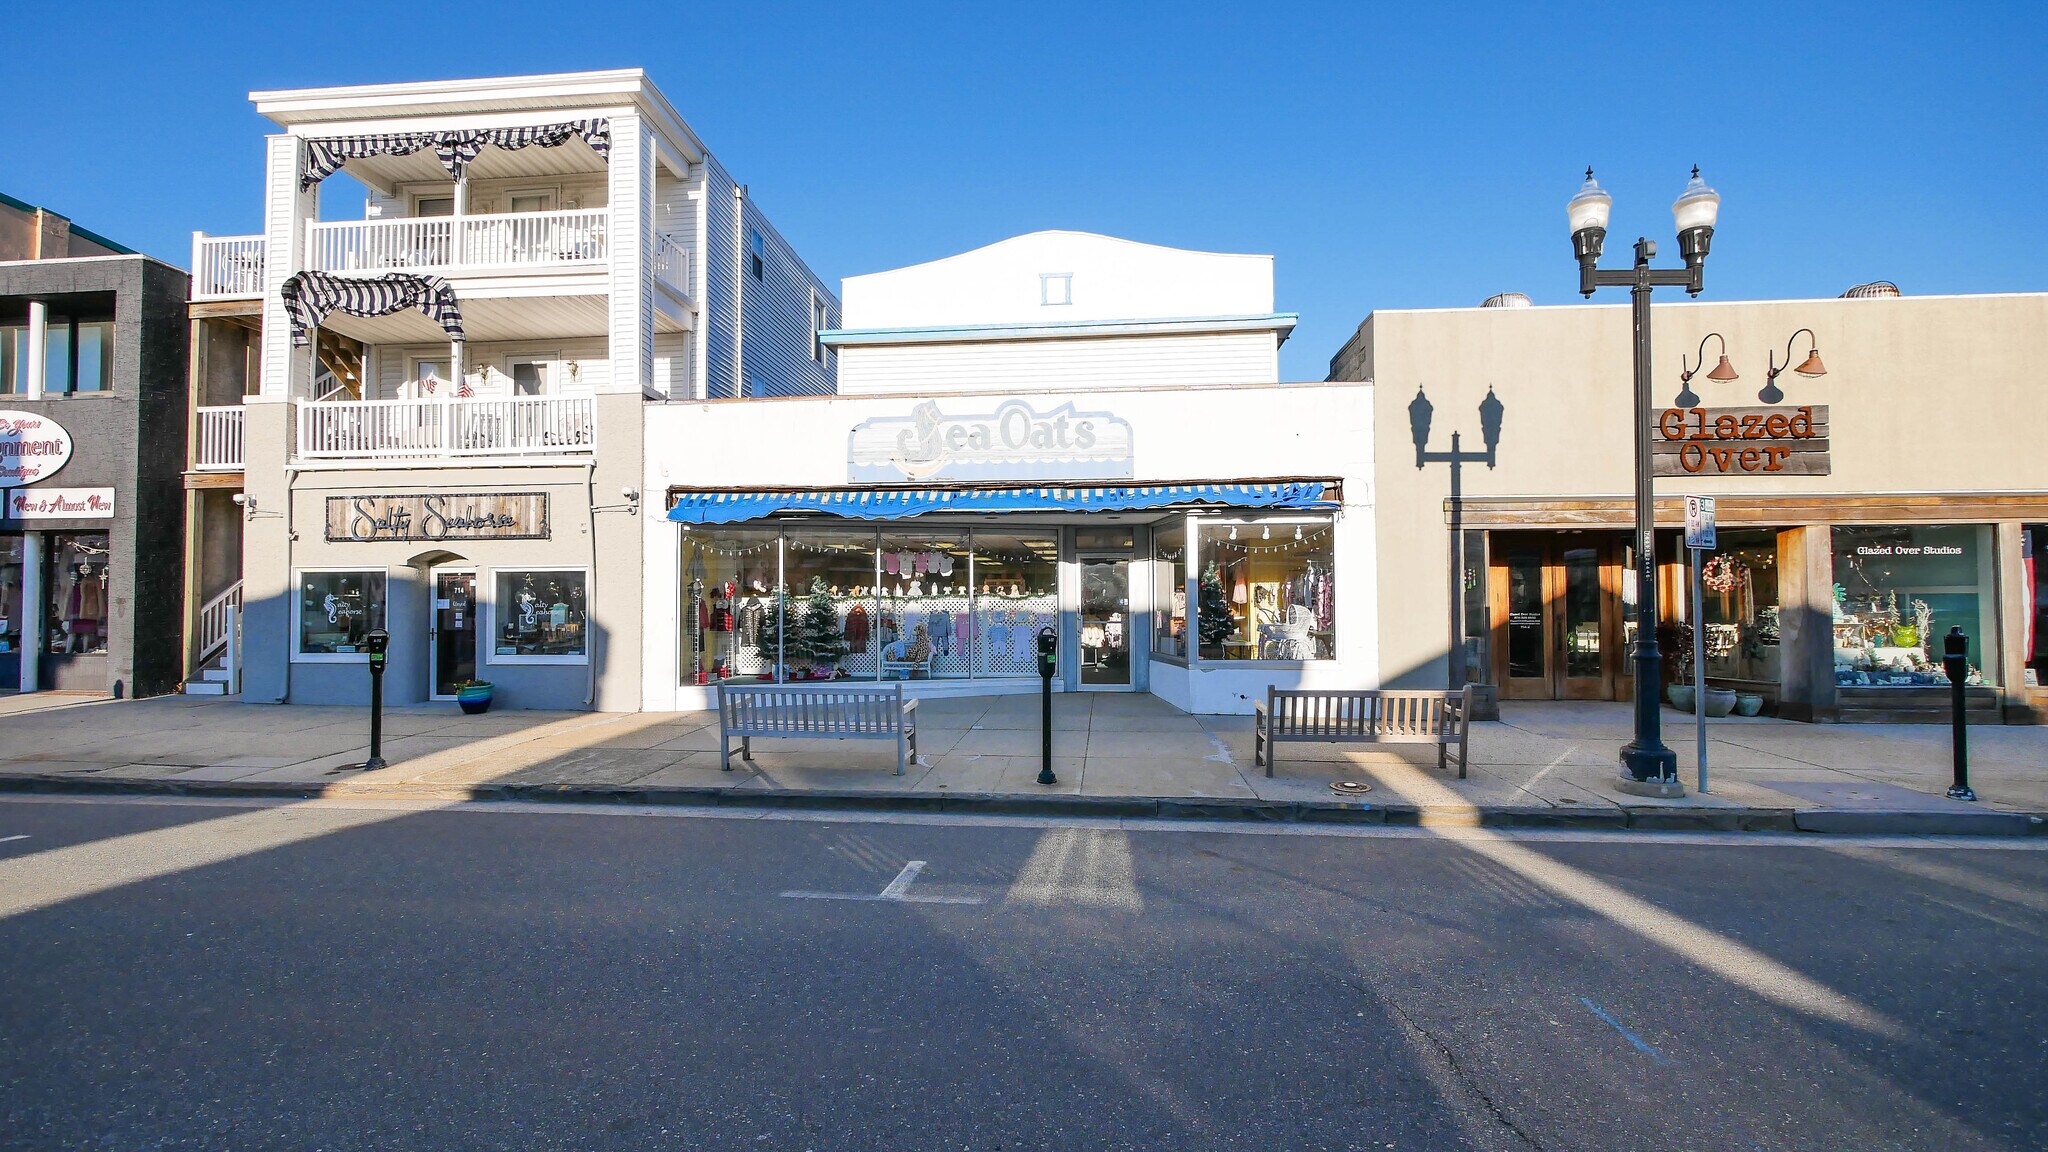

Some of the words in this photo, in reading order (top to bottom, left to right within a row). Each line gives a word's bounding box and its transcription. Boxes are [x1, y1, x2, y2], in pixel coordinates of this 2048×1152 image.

[896, 400, 991, 463] Sea
[1000, 408, 1096, 450] Oats
[1660, 406, 1816, 440] Glazed
[1680, 441, 1791, 473] Over
[13, 495, 38, 512] New
[48, 494, 86, 514] Almost
[87, 494, 112, 511] New
[351, 495, 411, 542] Salty
[422, 494, 516, 540] Seahorse
[1857, 546, 1892, 555] Glazed
[1895, 546, 1921, 555] Over
[1923, 546, 1962, 555] Studios
